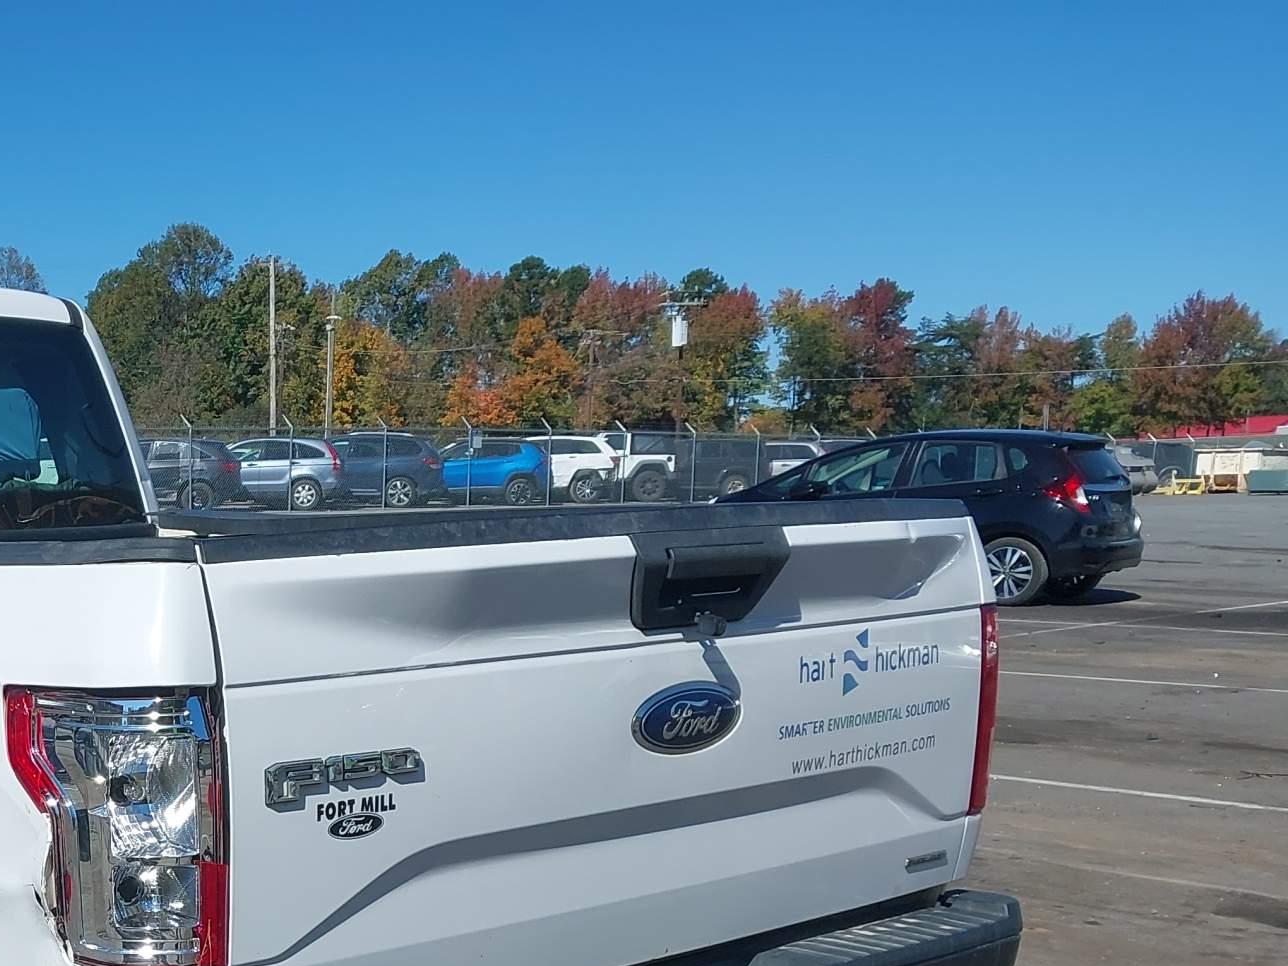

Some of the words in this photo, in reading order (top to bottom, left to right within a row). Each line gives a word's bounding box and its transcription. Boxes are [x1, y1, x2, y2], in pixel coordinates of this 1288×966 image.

[875, 643, 940, 673] hickman
[662, 699, 722, 740] Ford
[827, 707, 903, 732] ENVIRONMENTAL
[905, 697, 951, 718] SOLUTIONS
[791, 733, 936, 775] www.harthickman.com
[317, 799, 356, 822] FORT
[361, 793, 397, 813] MILL
